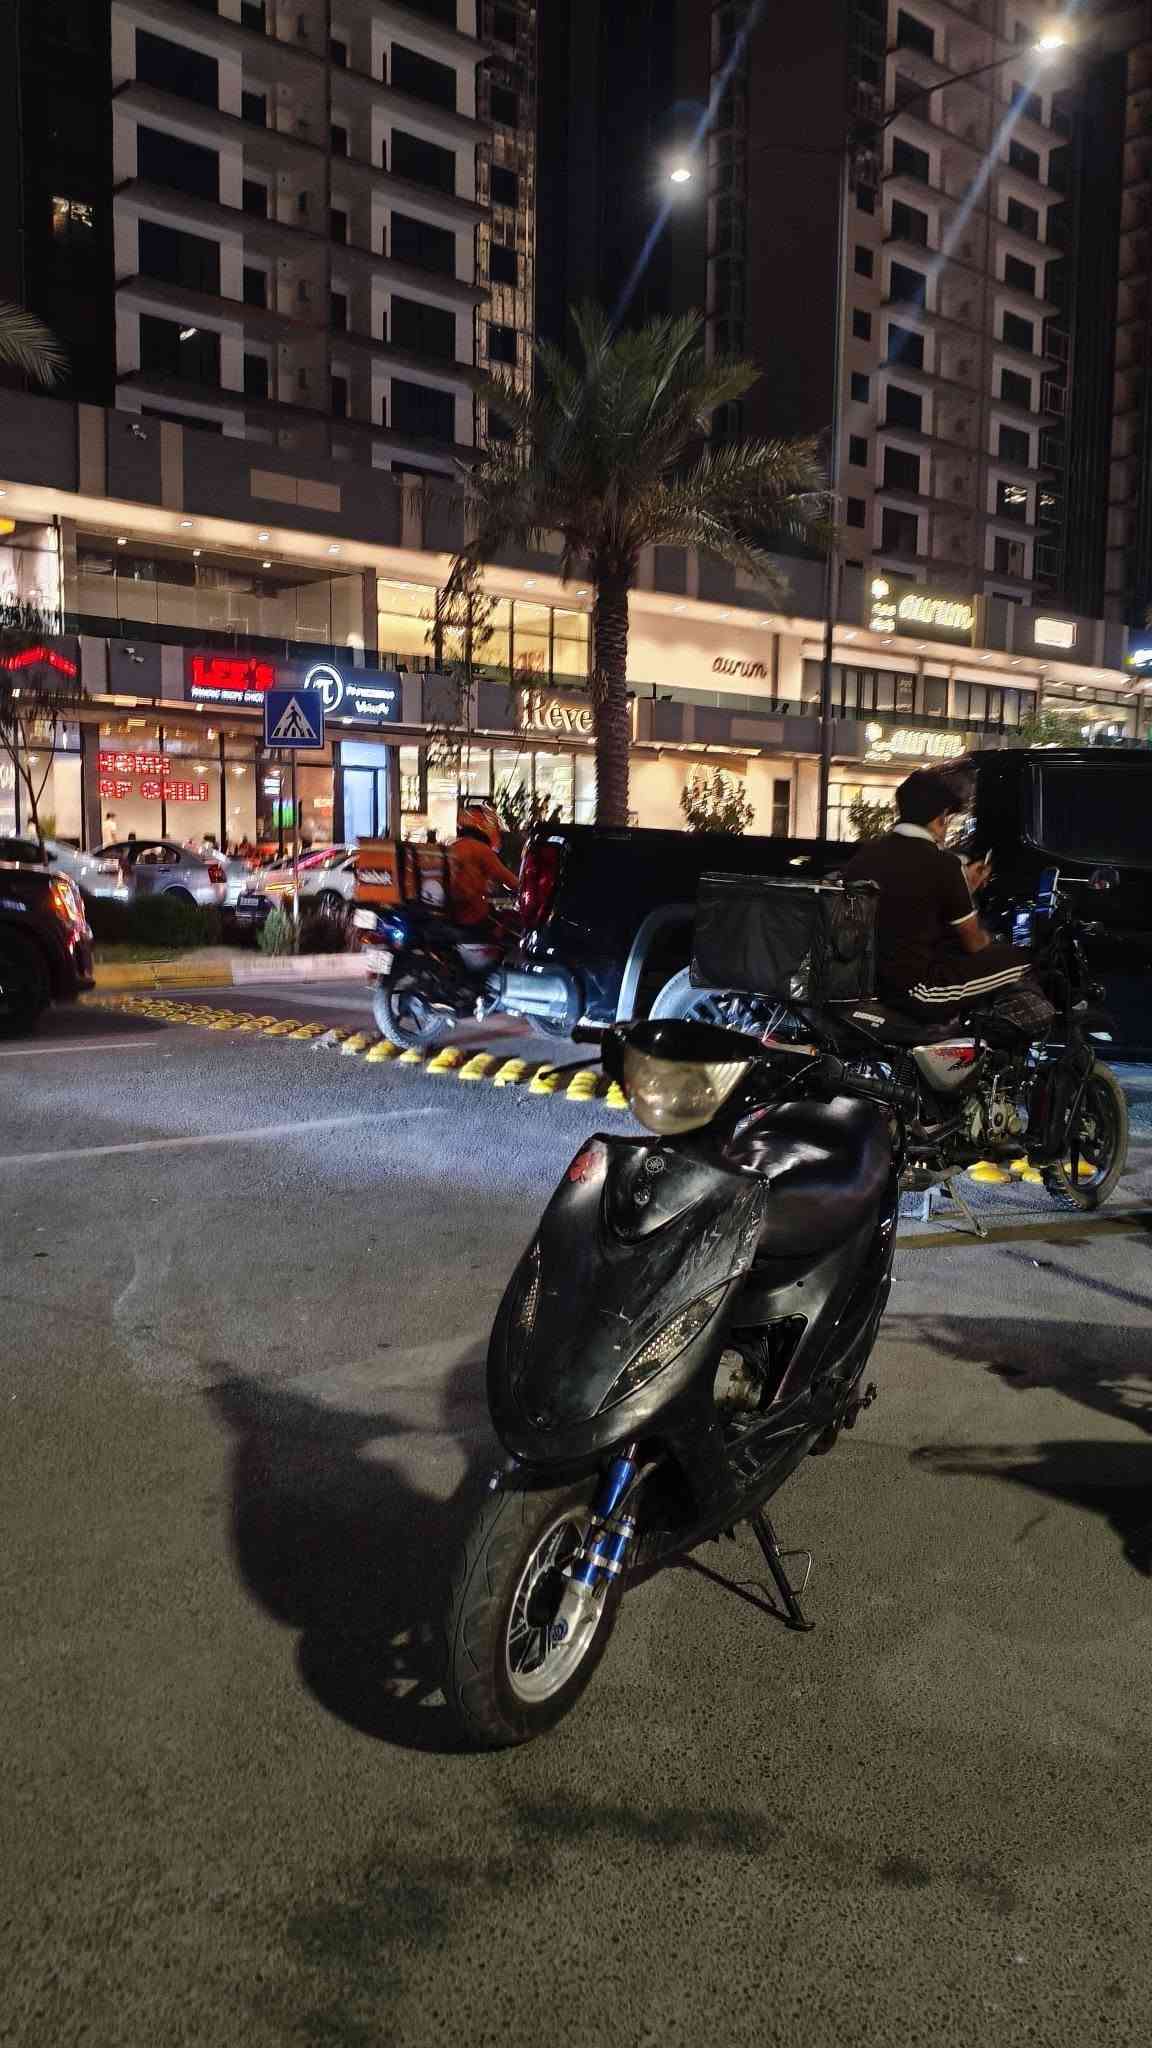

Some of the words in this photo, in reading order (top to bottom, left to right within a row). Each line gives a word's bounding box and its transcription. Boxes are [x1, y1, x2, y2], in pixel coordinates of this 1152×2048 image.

[712, 656, 768, 679] aurum
[99, 779, 133, 800] OF
[141, 781, 209, 801] CHILI
